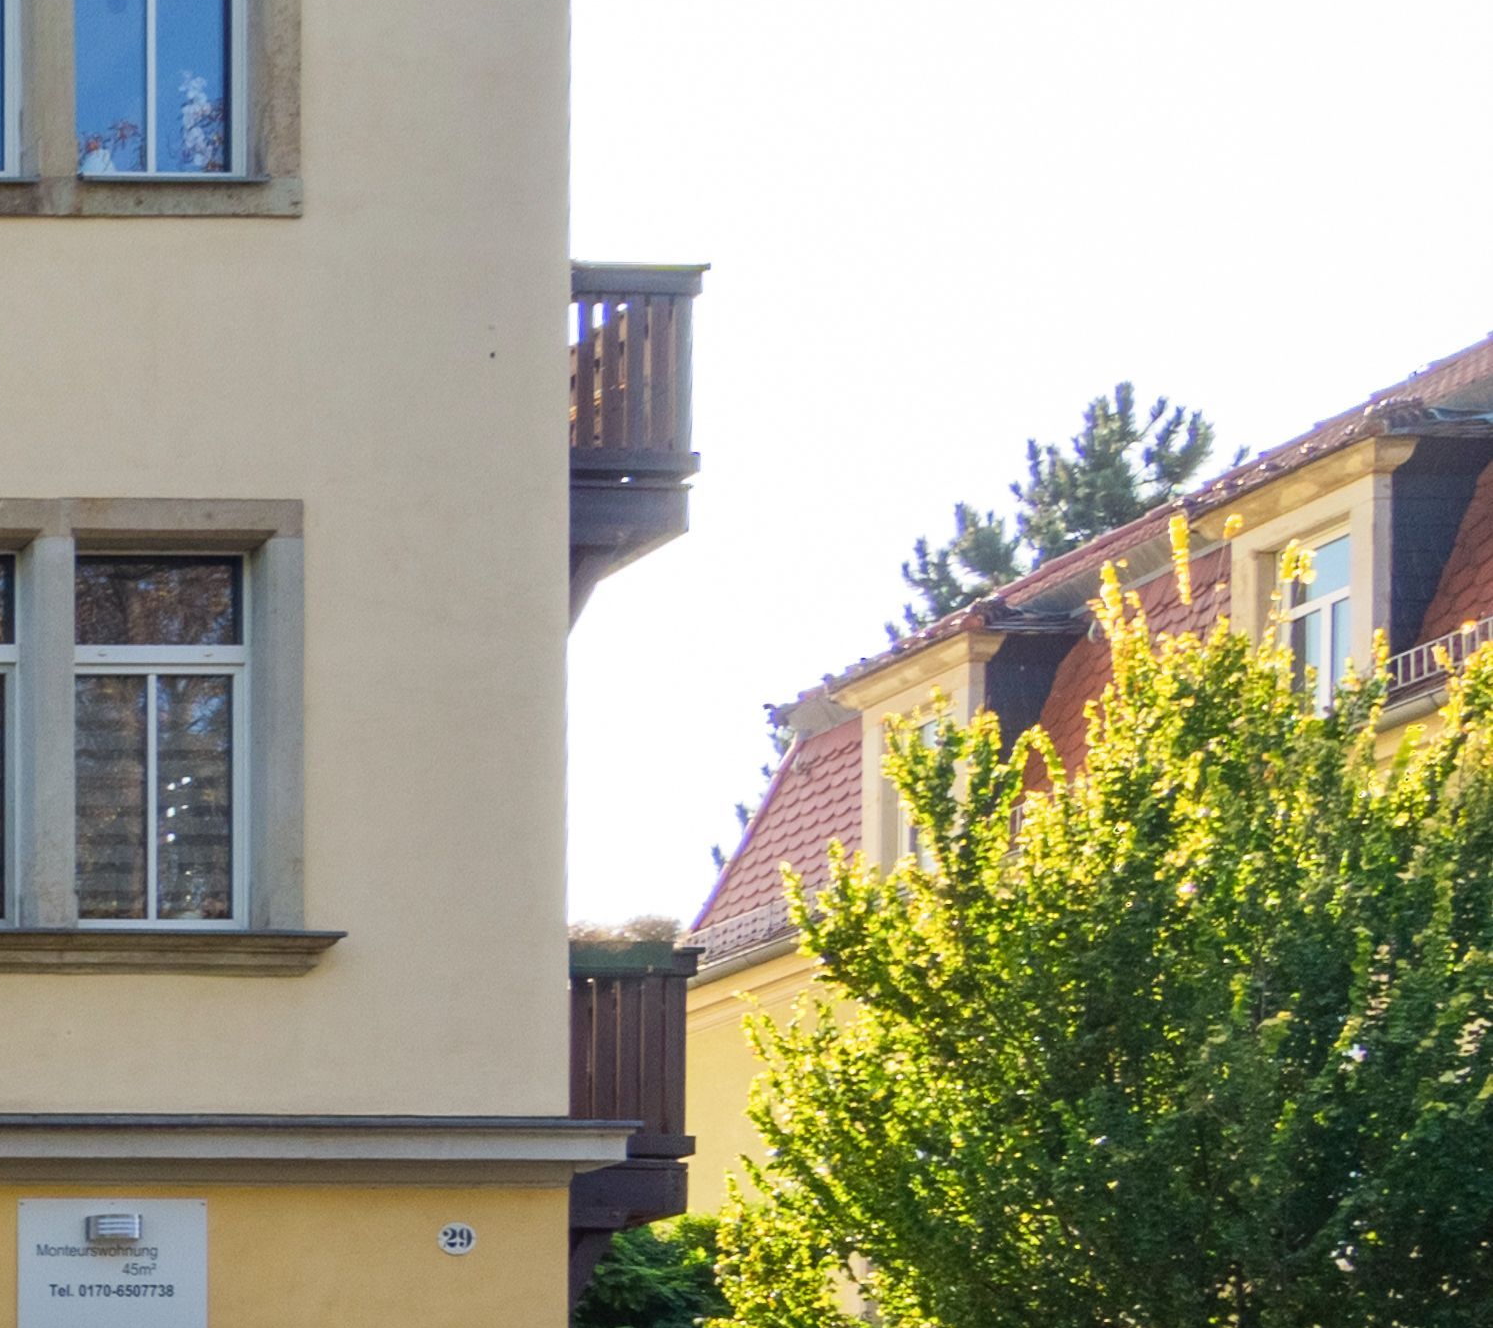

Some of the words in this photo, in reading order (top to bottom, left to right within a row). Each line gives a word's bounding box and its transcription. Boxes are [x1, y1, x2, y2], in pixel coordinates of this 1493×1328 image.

[442, 1227, 472, 1249] 29
[36, 1243, 158, 1260] Monteurswohnung
[49, 1284, 74, 1297] Tel.
[79, 1284, 174, 1297] 0170-6507738
